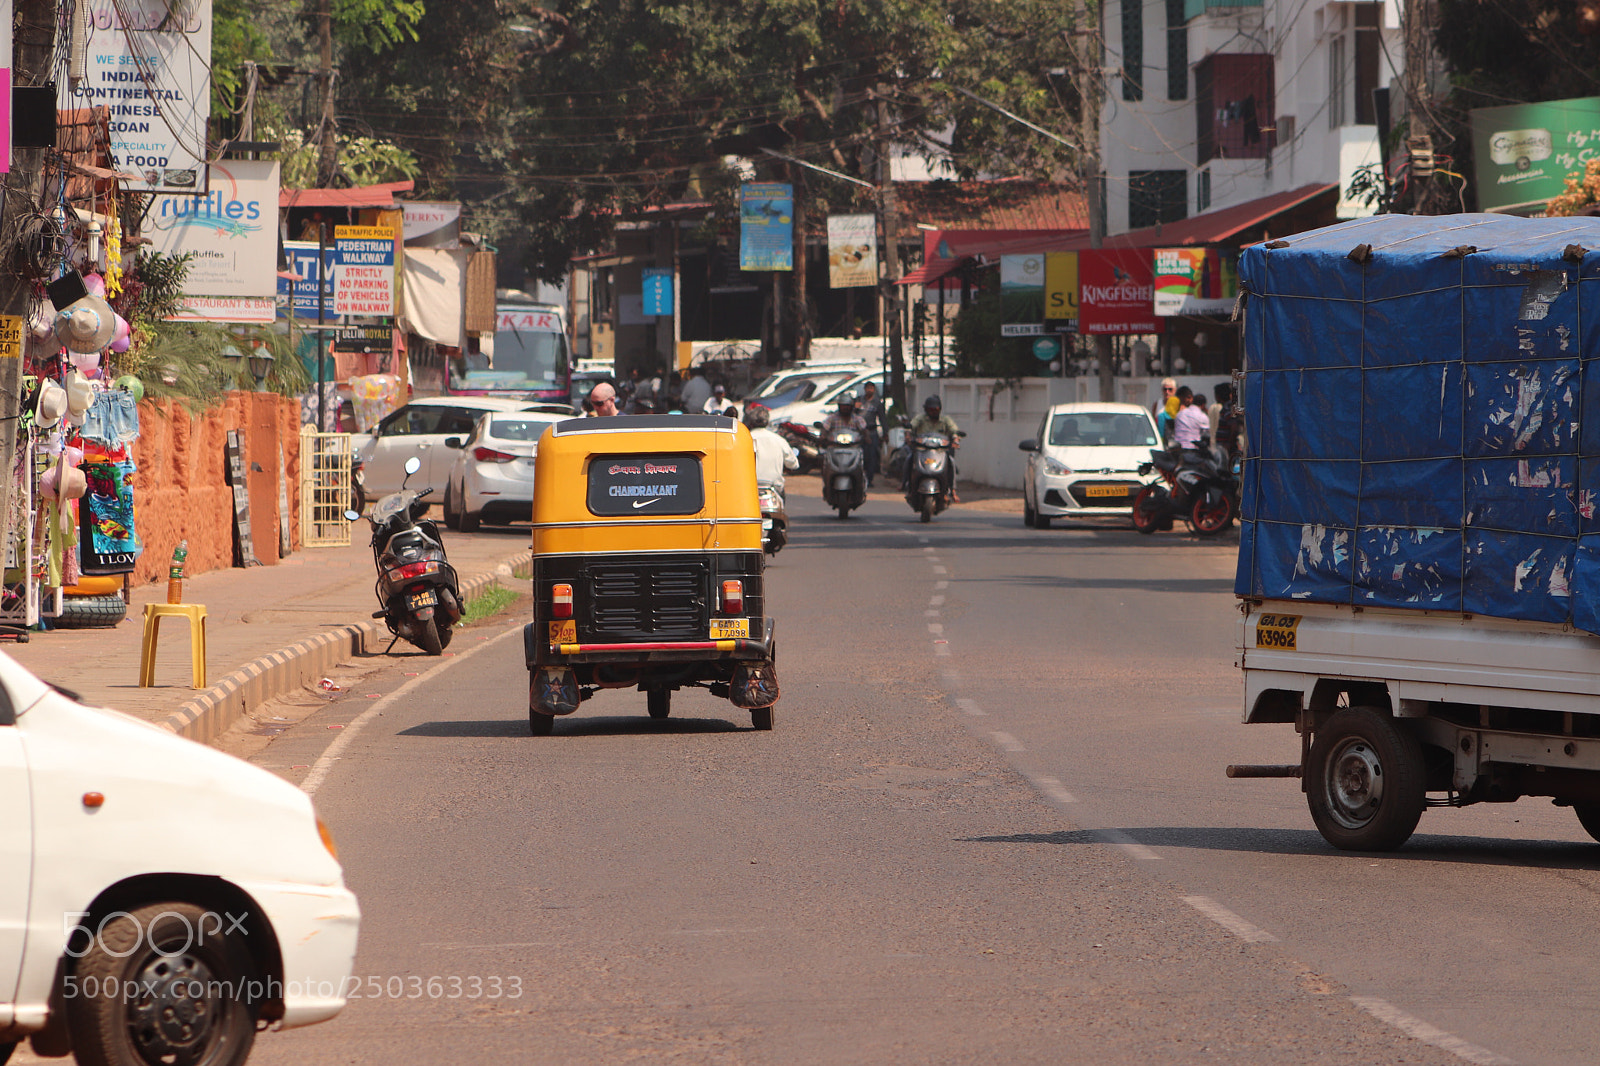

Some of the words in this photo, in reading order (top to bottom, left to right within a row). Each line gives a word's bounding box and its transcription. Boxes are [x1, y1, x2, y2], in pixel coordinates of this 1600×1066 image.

[96, 54, 115, 65] WE
[101, 71, 156, 83] INDIAN
[75, 86, 183, 101] CONTINENTAL
[96, 104, 162, 116] HINESE
[107, 121, 150, 133] GOAN
[111, 141, 167, 151] SPECIALITY
[126, 155, 169, 168] FOOD
[161, 190, 260, 220] ruffles
[337, 241, 392, 252] PEDESTRIAN
[342, 253, 386, 264] WALKWAY
[345, 268, 382, 278] STRICTLY
[298, 283, 331, 293] HOUS
[340, 280, 351, 288] NO
[353, 280, 388, 290] PARKING
[338, 291, 349, 300] OF
[350, 291, 389, 301] VEHICLES
[183, 298, 241, 308] RESTAURANT
[244, 300, 251, 308] &
[254, 300, 273, 309] BAR
[337, 302, 348, 312] ON
[351, 303, 390, 313] WALKWAY
[497, 314, 553, 329] KAR
[608, 485, 678, 497] CHANDRAKANT
[99, 555, 105, 564] I
